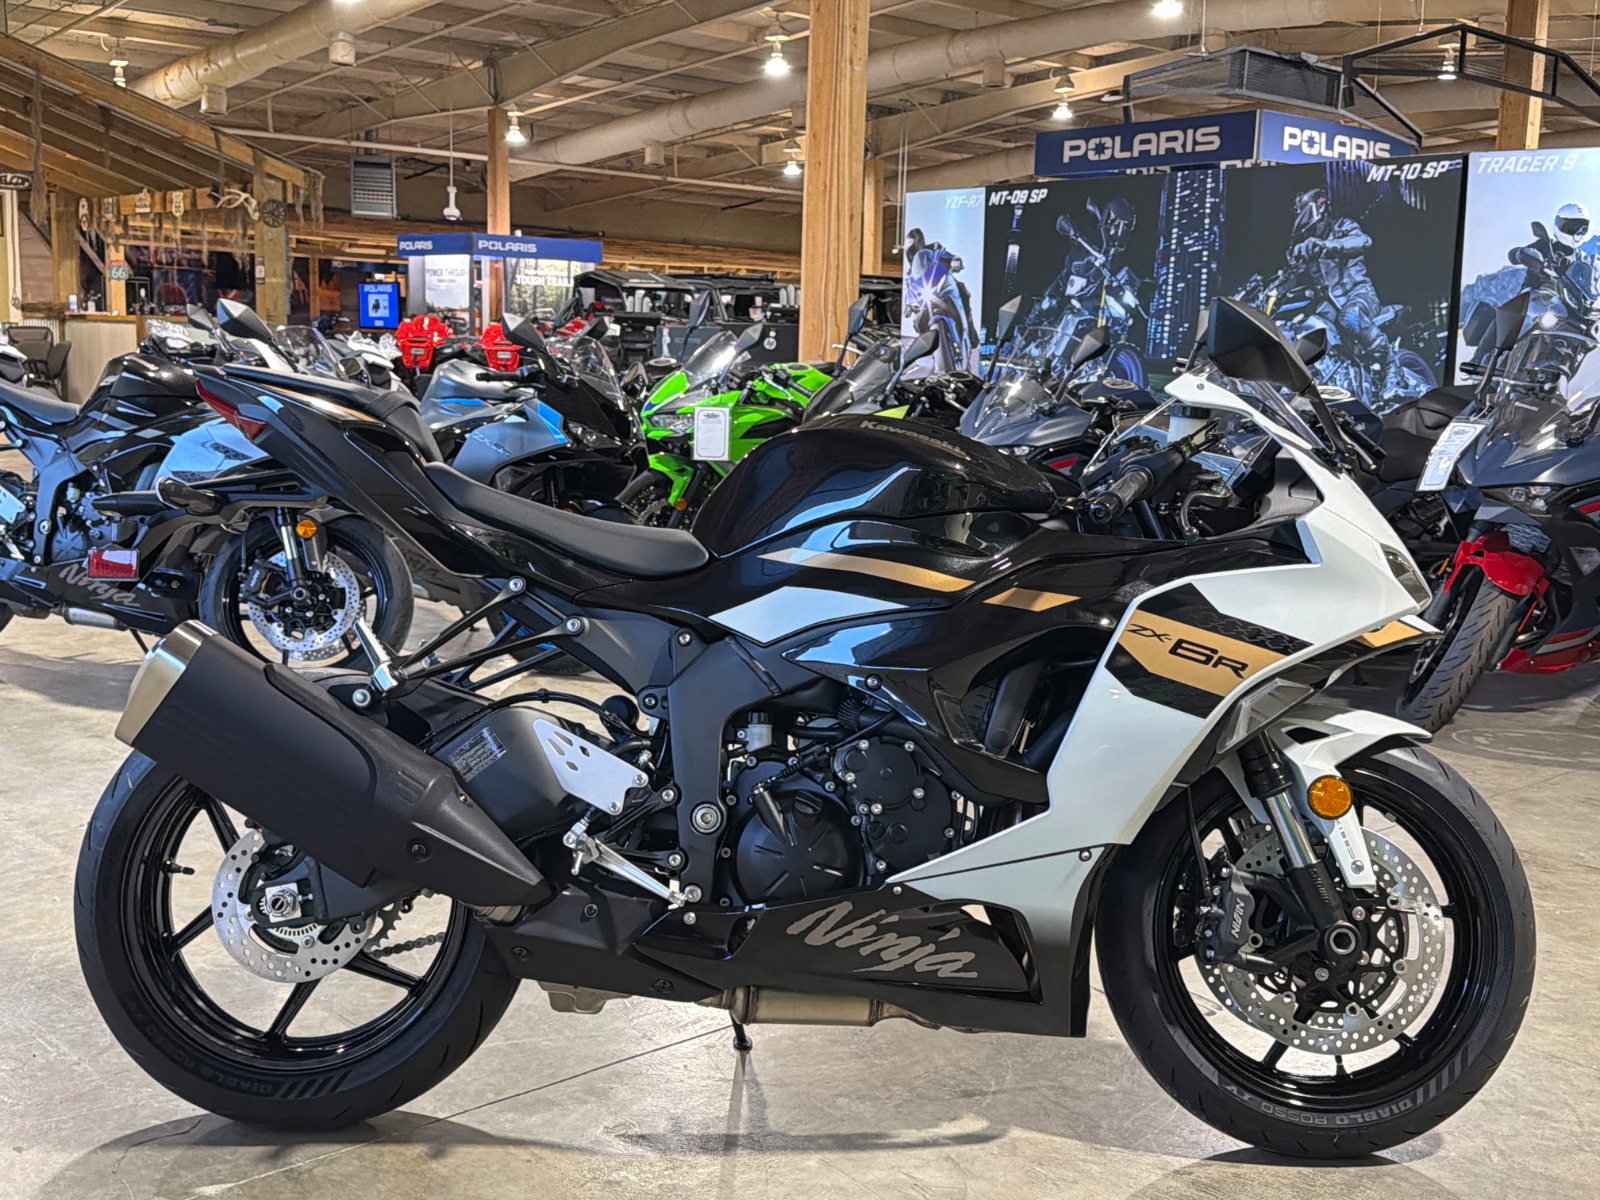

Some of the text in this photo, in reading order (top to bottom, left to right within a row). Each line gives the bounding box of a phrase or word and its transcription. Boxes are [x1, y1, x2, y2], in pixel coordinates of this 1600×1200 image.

[1062, 126, 1222, 164] POLARIS
[1283, 125, 1392, 159] POLARIS
[1366, 160, 1450, 183] MT-10 SP
[1477, 153, 1580, 174] TRACER 9
[945, 194, 984, 209] YZF-R7
[988, 188, 1049, 207] MT-09 SP
[399, 241, 434, 251] POLARIS
[478, 240, 538, 253] POLARIS
[111, 267, 127, 279] 66
[860, 420, 968, 457] Kawasaki
[1125, 623, 1250, 680] ZX-6R
[786, 901, 979, 978] Ninja
[1260, 1102, 1328, 1126] ROSSO
[1335, 1098, 1414, 1126] DIABLO
